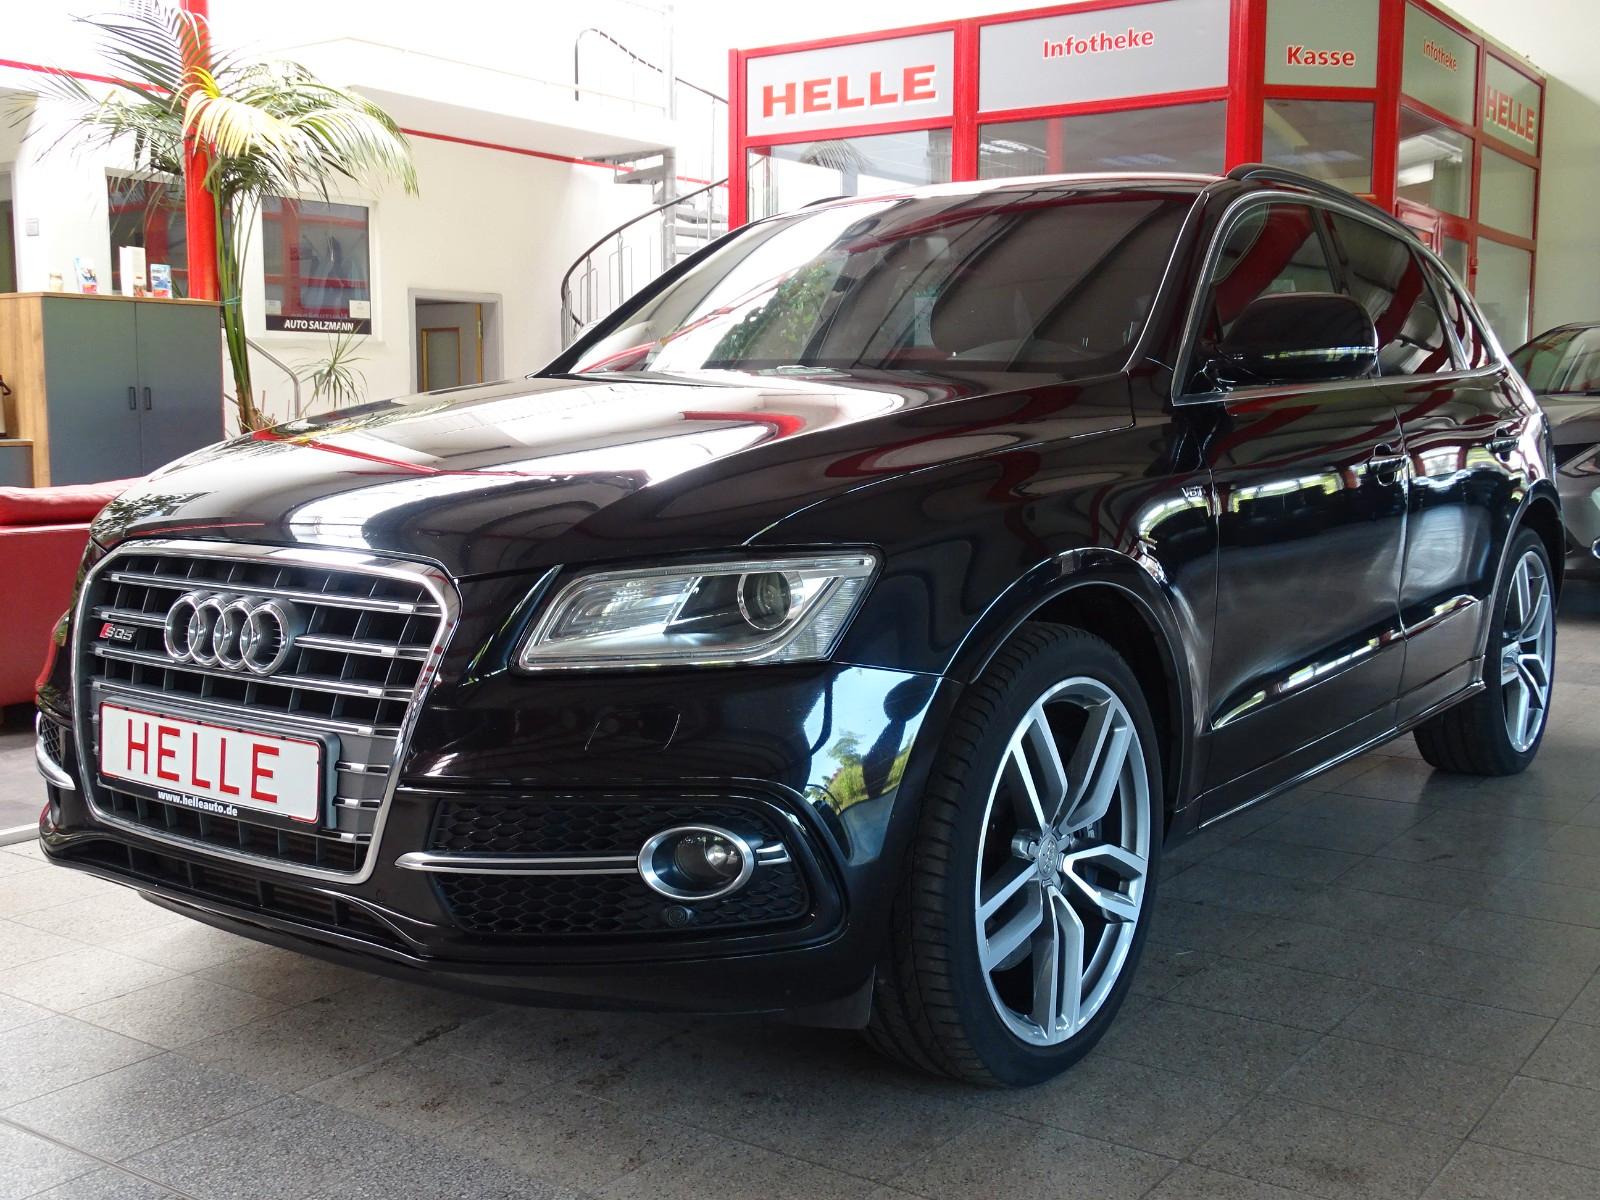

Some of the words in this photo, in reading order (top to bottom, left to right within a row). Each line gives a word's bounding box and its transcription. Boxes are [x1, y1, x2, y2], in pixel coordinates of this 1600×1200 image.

[1043, 28, 1155, 58] Infotheke
[1286, 46, 1356, 67] Kasse
[763, 64, 937, 118] HELLE
[1485, 85, 1536, 143] HELLE
[284, 319, 308, 329] AUTO
[308, 320, 354, 331] SALZMANN
[127, 718, 280, 804] HELLE
[158, 790, 238, 817] www.helleauto.de
